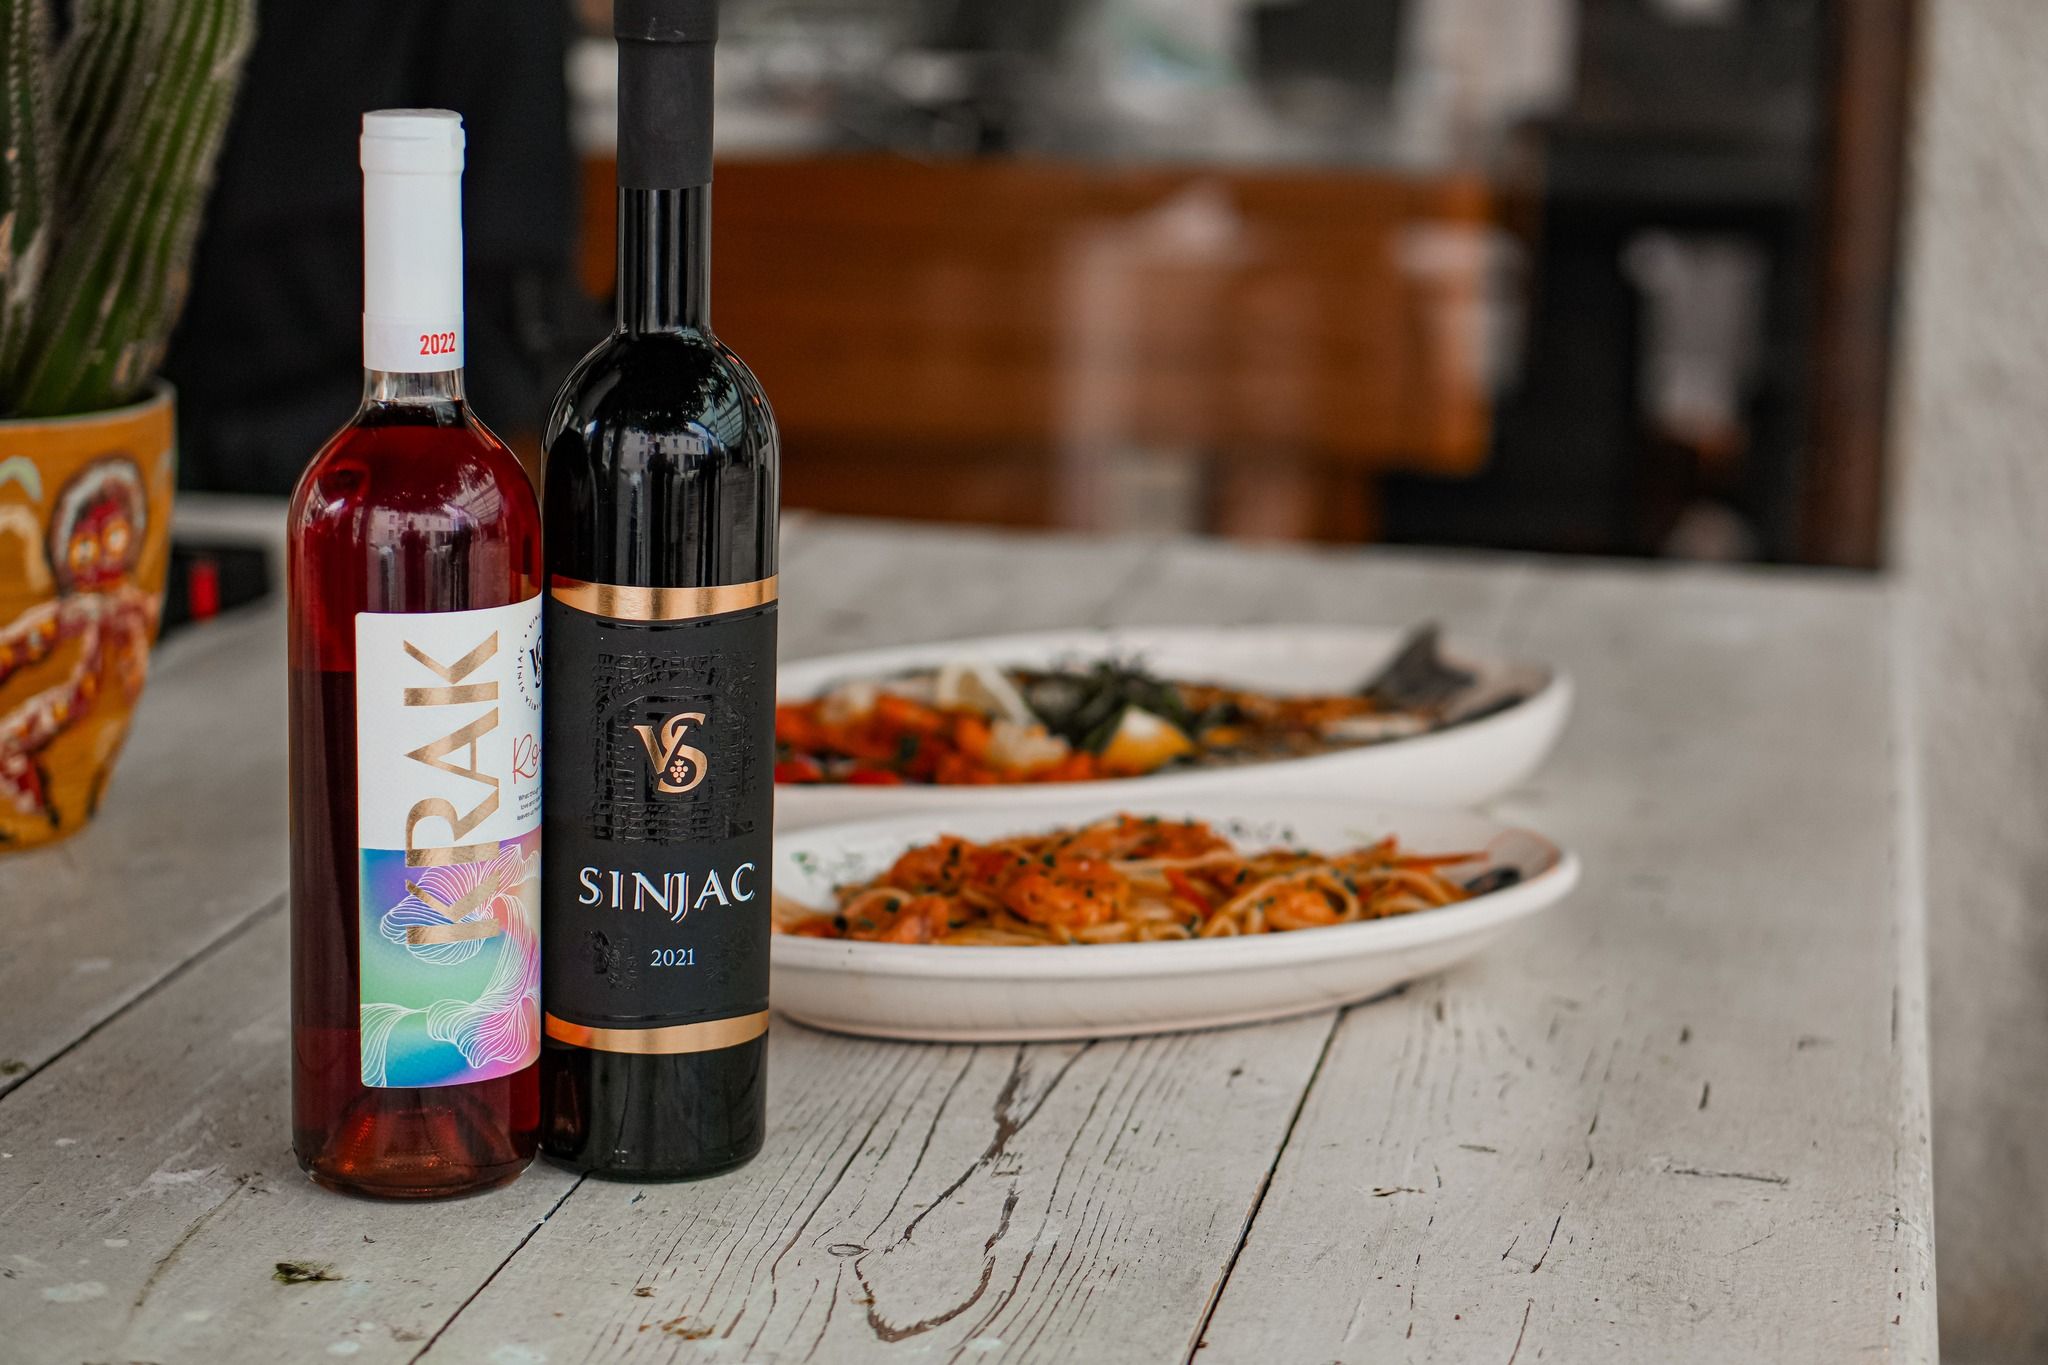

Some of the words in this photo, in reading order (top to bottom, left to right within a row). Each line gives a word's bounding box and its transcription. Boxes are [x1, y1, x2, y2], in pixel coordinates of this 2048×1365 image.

[419, 331, 456, 356] 2022
[633, 711, 709, 794] VS
[403, 629, 501, 945] KRAK
[577, 861, 757, 924] SINJAC
[649, 947, 697, 968] 2021
